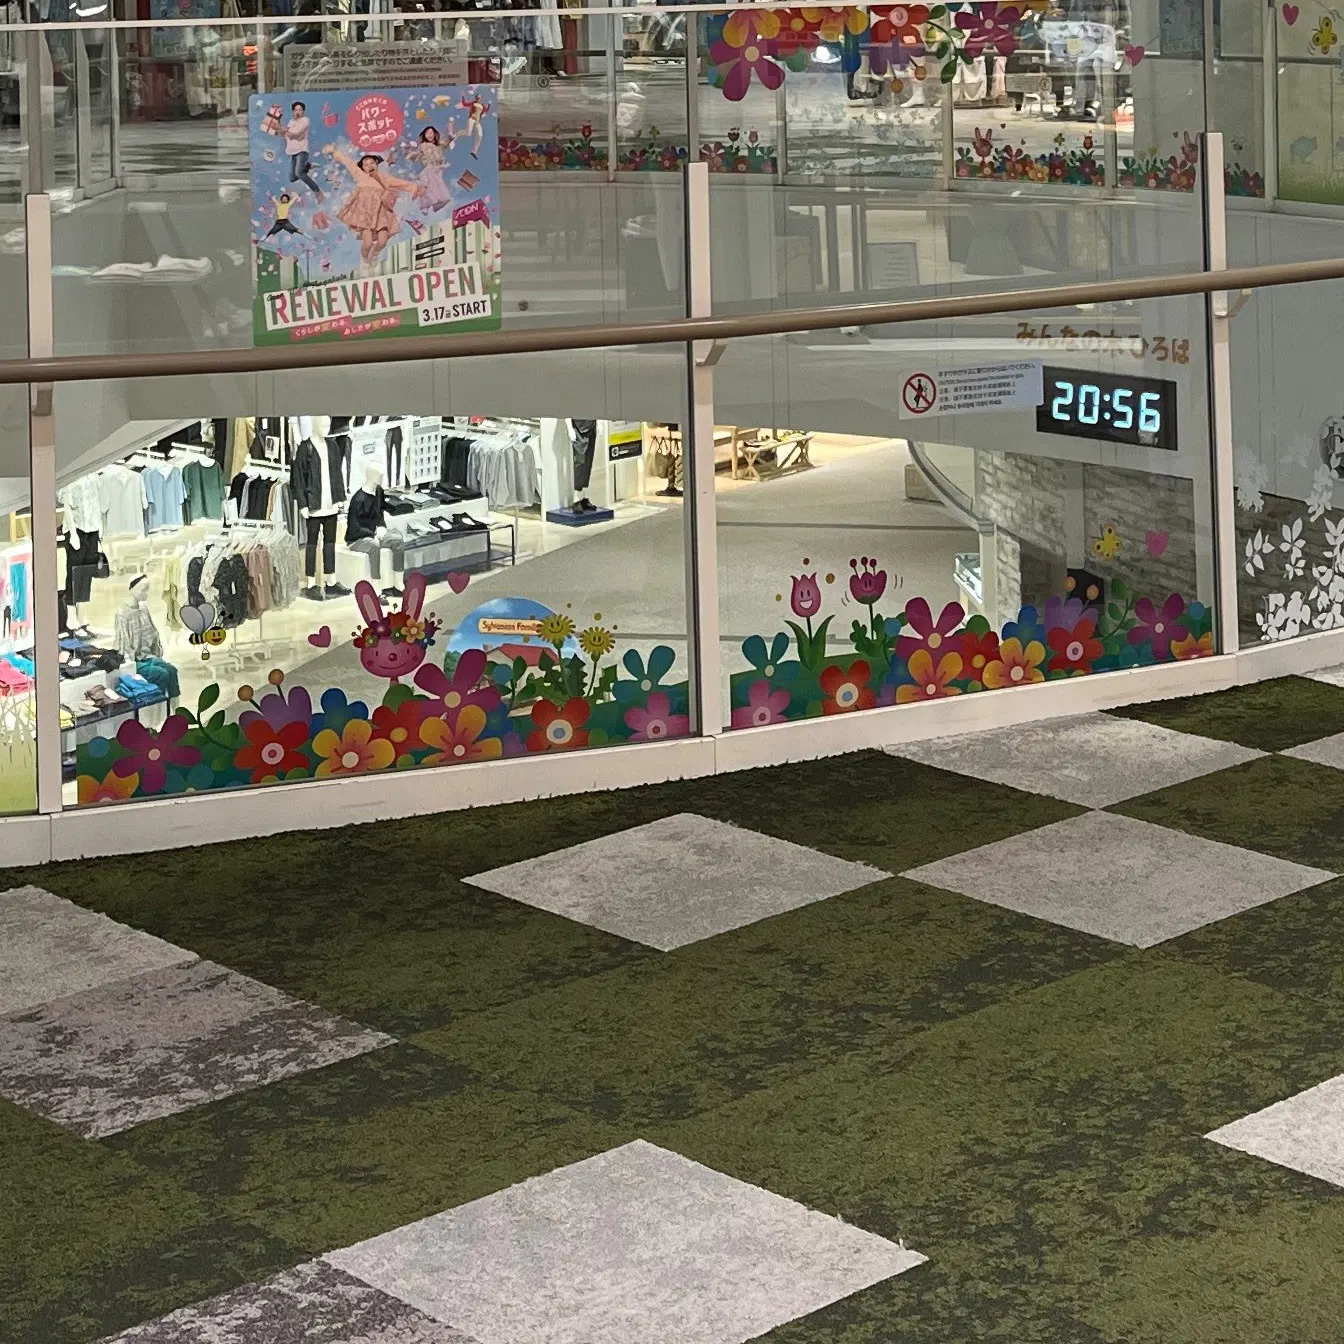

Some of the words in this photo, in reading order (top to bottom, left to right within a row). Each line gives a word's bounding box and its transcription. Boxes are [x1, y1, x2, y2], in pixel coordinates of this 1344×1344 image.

[361, 107, 387, 120] パワー
[358, 117, 394, 134] スポット
[270, 278, 402, 325] RENEWAL
[408, 265, 476, 303] OPEN
[423, 307, 445, 322] 3.17
[452, 300, 488, 317] START
[1052, 381, 1161, 433] 20:56
